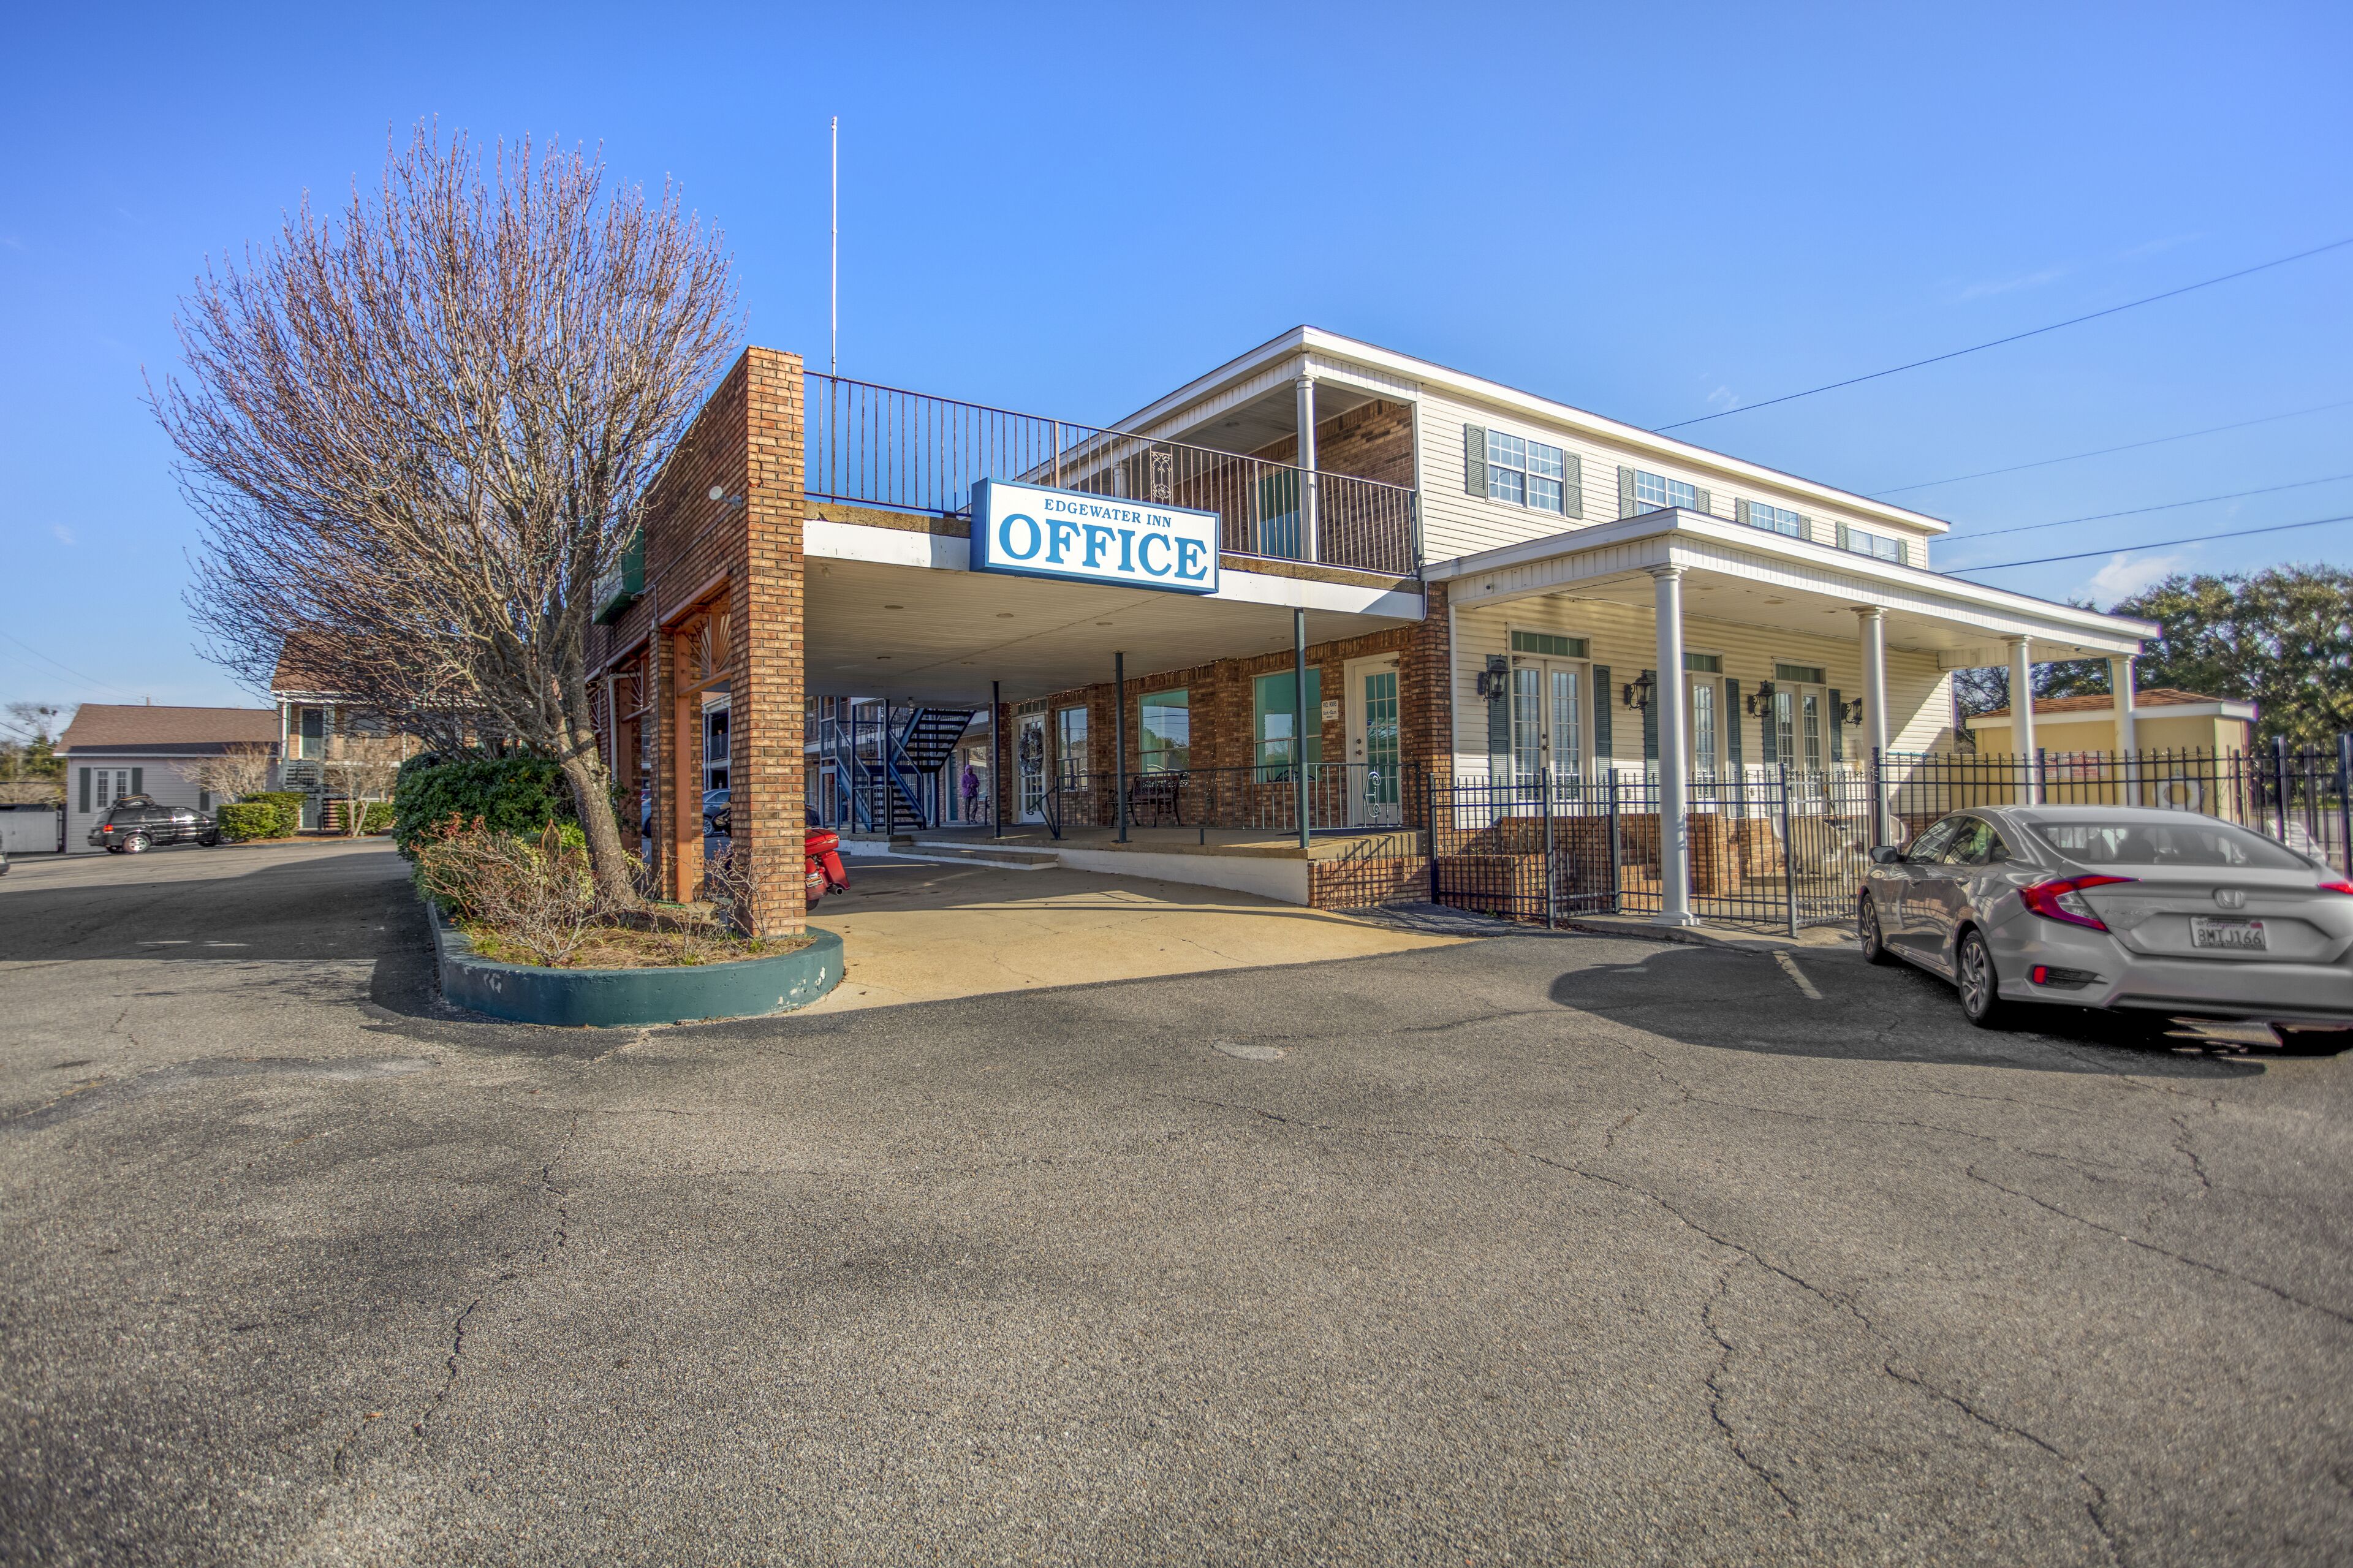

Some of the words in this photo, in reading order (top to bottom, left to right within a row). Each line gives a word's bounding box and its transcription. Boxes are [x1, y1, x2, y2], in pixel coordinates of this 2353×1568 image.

[1044, 499, 1141, 524] EDGEWATER
[1146, 513, 1172, 528] INN
[999, 513, 1207, 580] OFFICE
